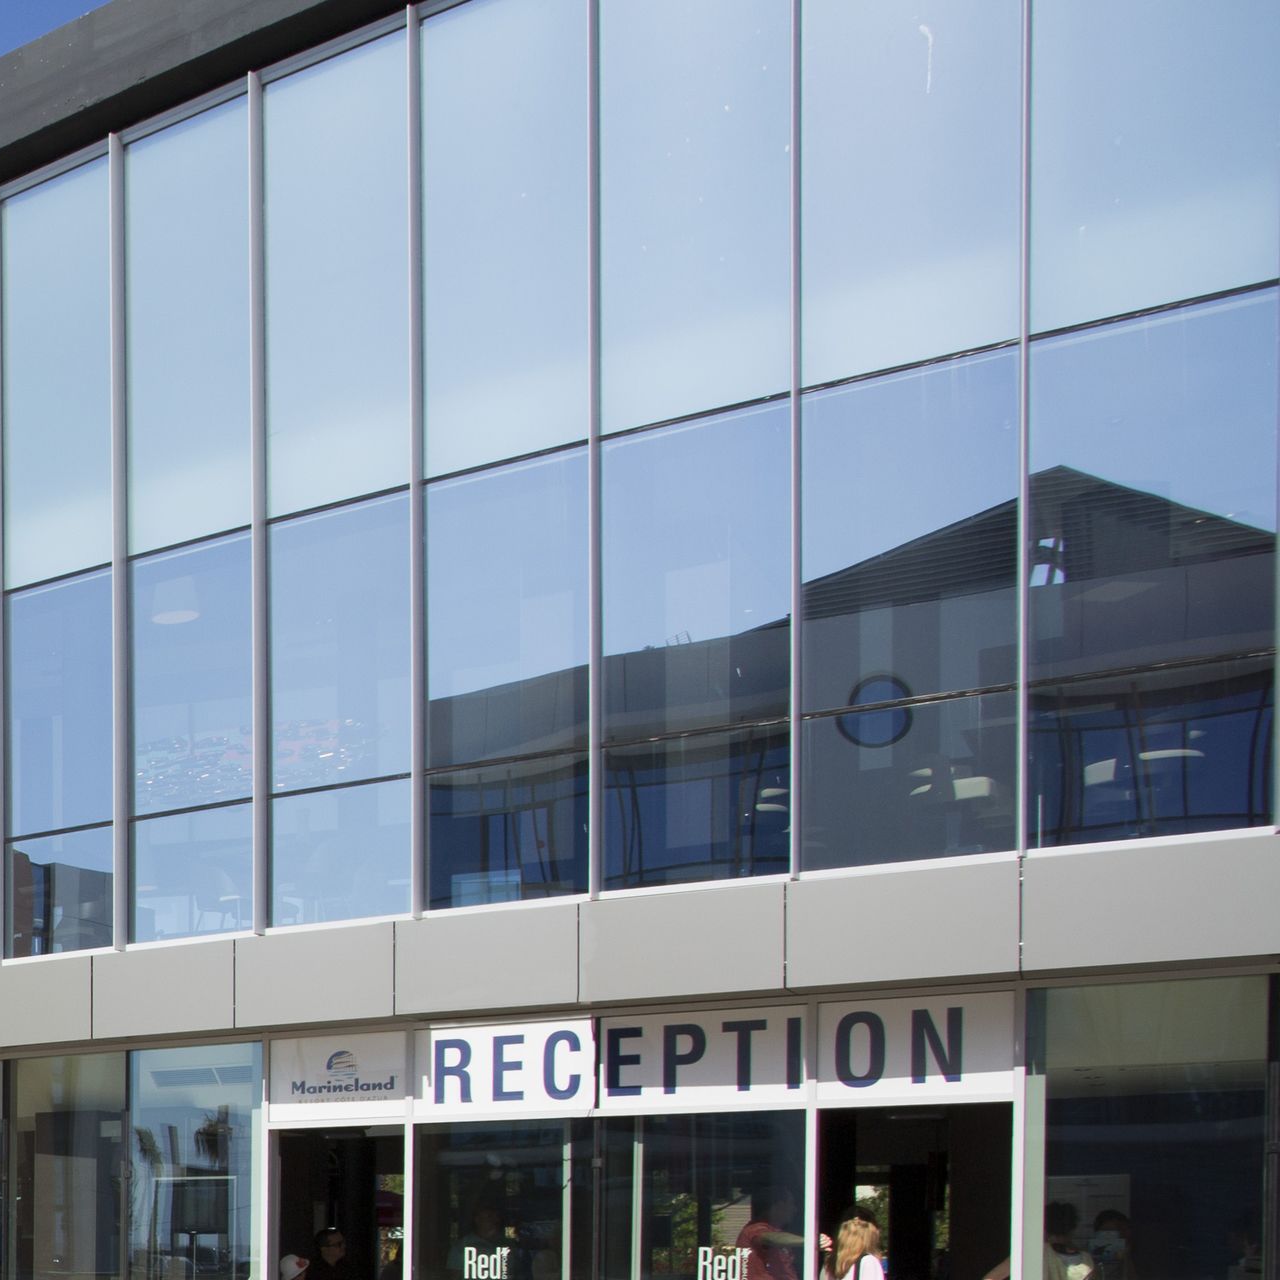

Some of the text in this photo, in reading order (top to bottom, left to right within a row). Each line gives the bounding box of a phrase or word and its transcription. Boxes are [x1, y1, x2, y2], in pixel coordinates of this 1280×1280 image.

[434, 1006, 963, 1104] RECEPTION
[292, 1076, 395, 1095] Marineland
[464, 1246, 501, 1280] Red
